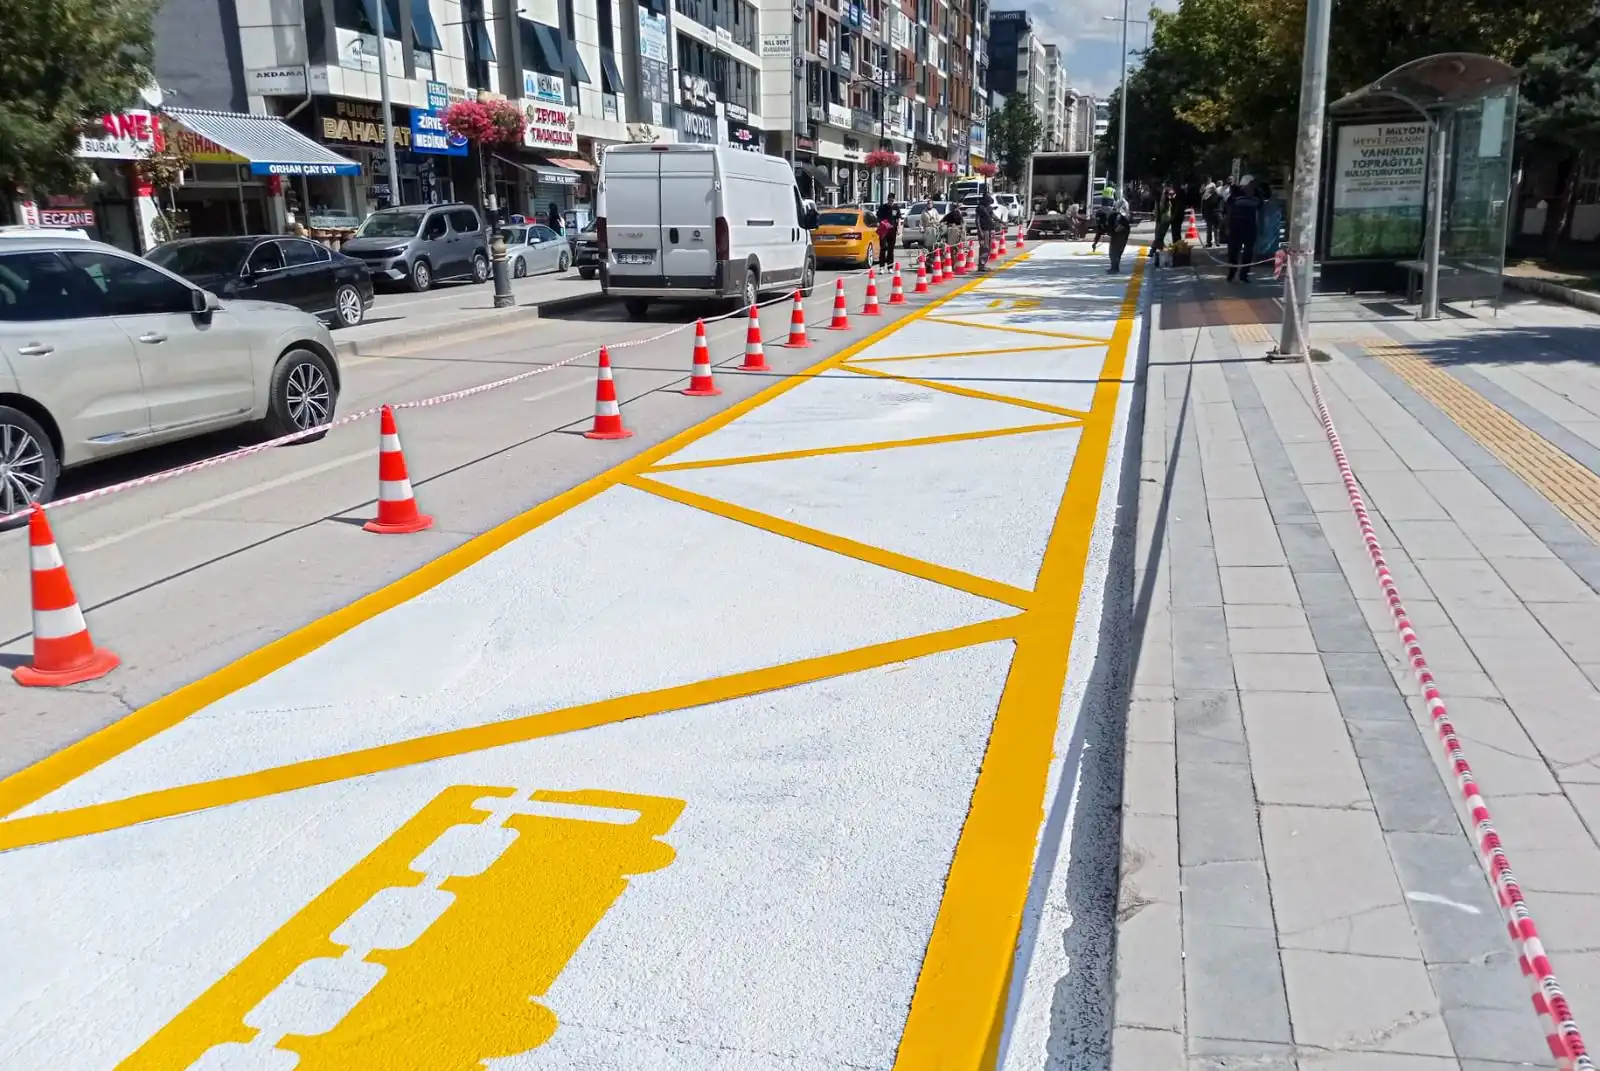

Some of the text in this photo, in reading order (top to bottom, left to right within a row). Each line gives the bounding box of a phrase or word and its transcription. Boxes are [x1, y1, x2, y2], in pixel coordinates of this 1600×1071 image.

[684, 113, 713, 139] MODEL
[85, 140, 121, 153] BURAK
[268, 164, 302, 174] ORHAN
[303, 165, 319, 175] ÇAY
[42, 212, 94, 225] ECZANE
